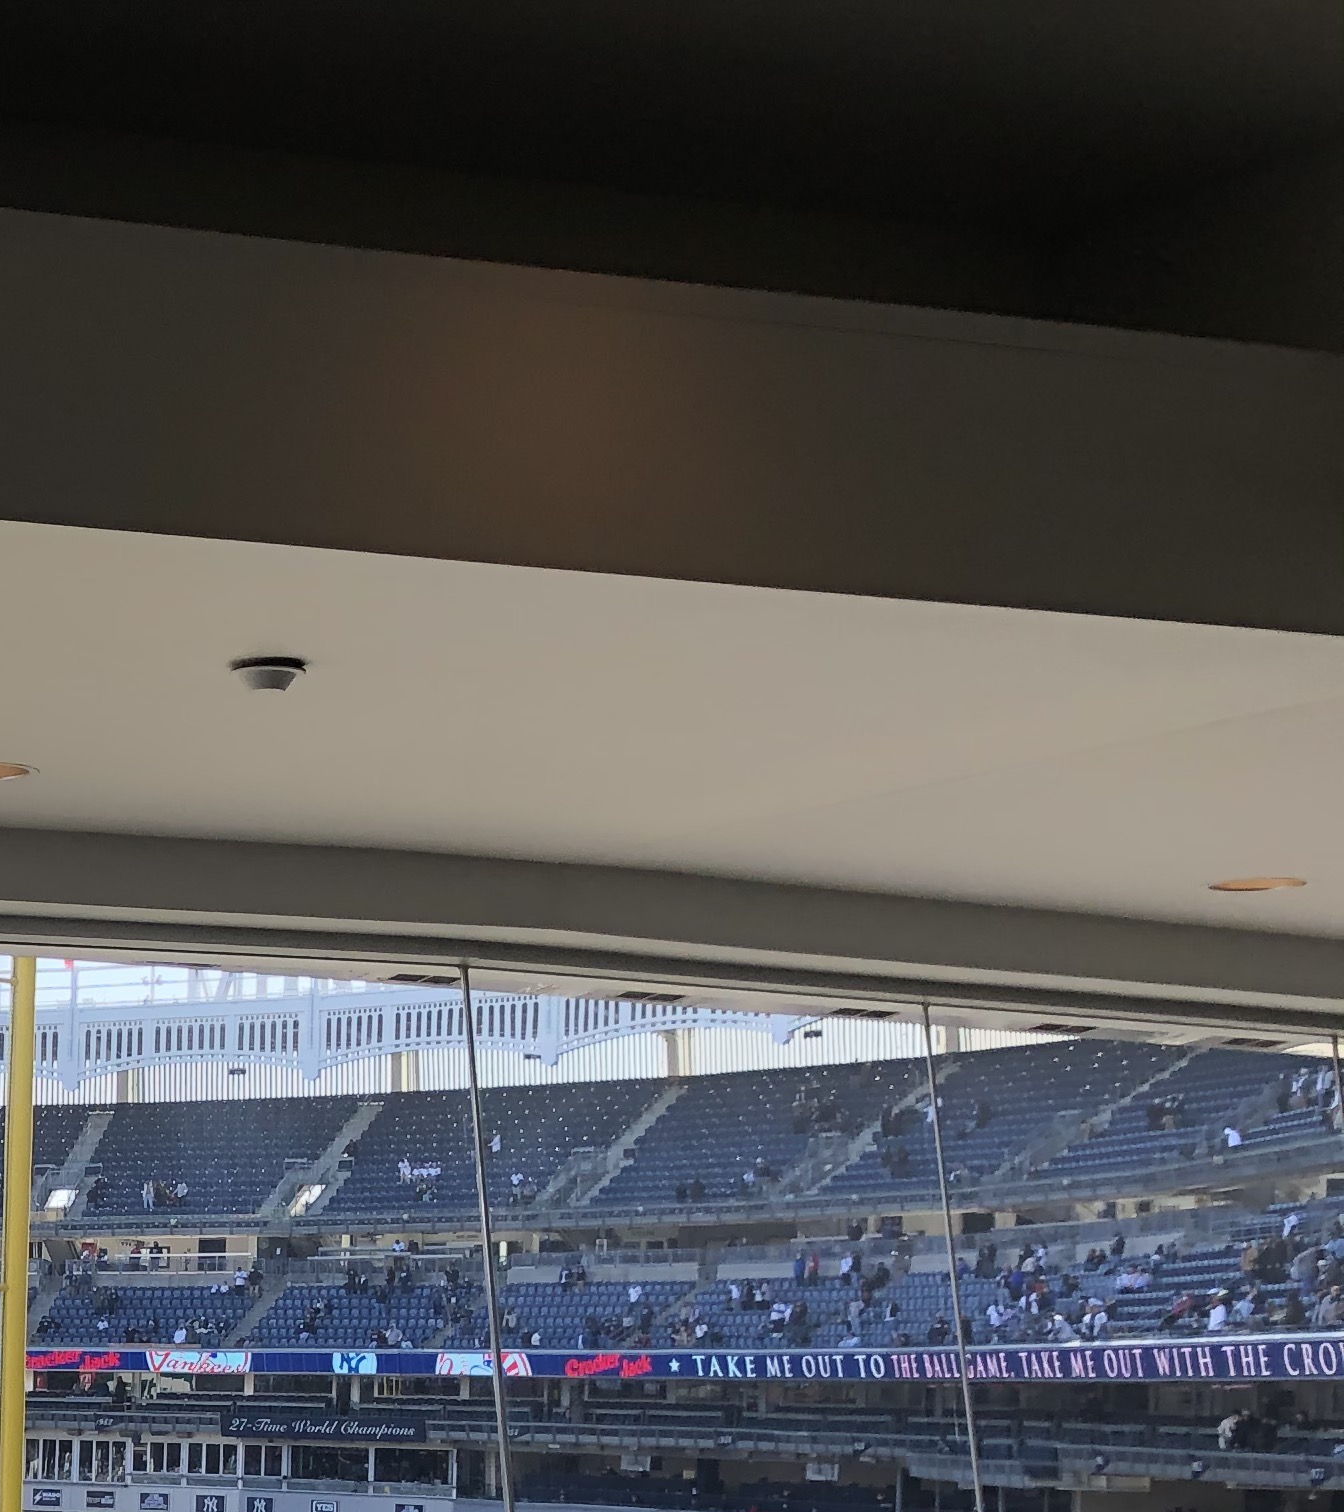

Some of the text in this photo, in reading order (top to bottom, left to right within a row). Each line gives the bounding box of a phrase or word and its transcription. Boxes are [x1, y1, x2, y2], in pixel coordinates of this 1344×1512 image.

[694, 1342, 1344, 1379] TAKE ME OUT TO THE BALL GAME, TAKE ME OUT WITH THE CRO
[228, 1417, 416, 1440] 27-Time World Champions
[315, 1503, 334, 1512] YES
